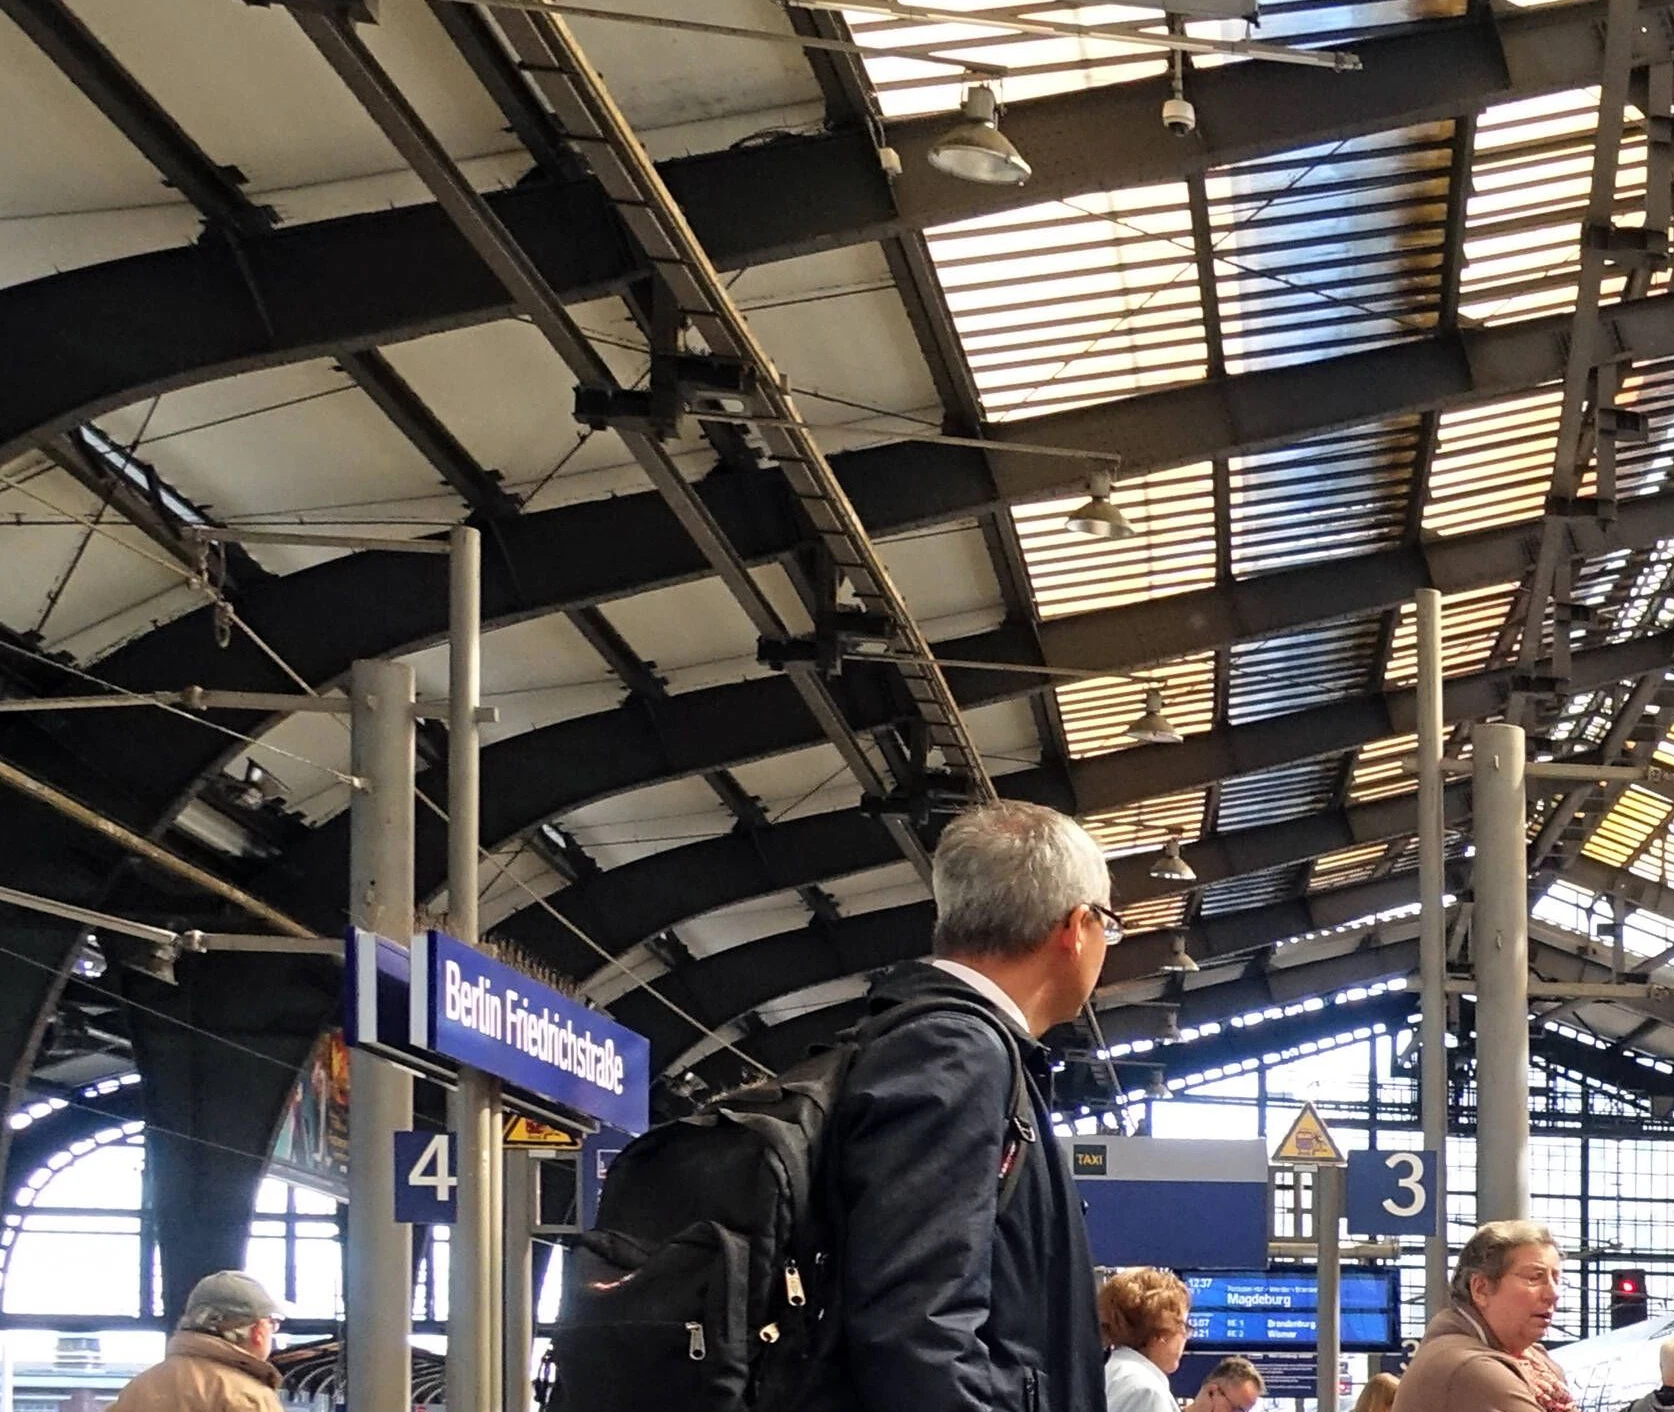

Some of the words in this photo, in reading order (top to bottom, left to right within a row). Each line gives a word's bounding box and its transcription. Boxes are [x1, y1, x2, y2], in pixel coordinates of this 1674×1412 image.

[445, 960, 502, 1040] Berlin
[506, 989, 624, 1095] Friedrichstraße
[408, 1133, 458, 1201] 4
[1077, 1153, 1103, 1166] TAXI
[1382, 1152, 1426, 1217] 3
[1227, 1292, 1292, 1308] Magdeburg
[1267, 1319, 1317, 1330] Brandenburg
